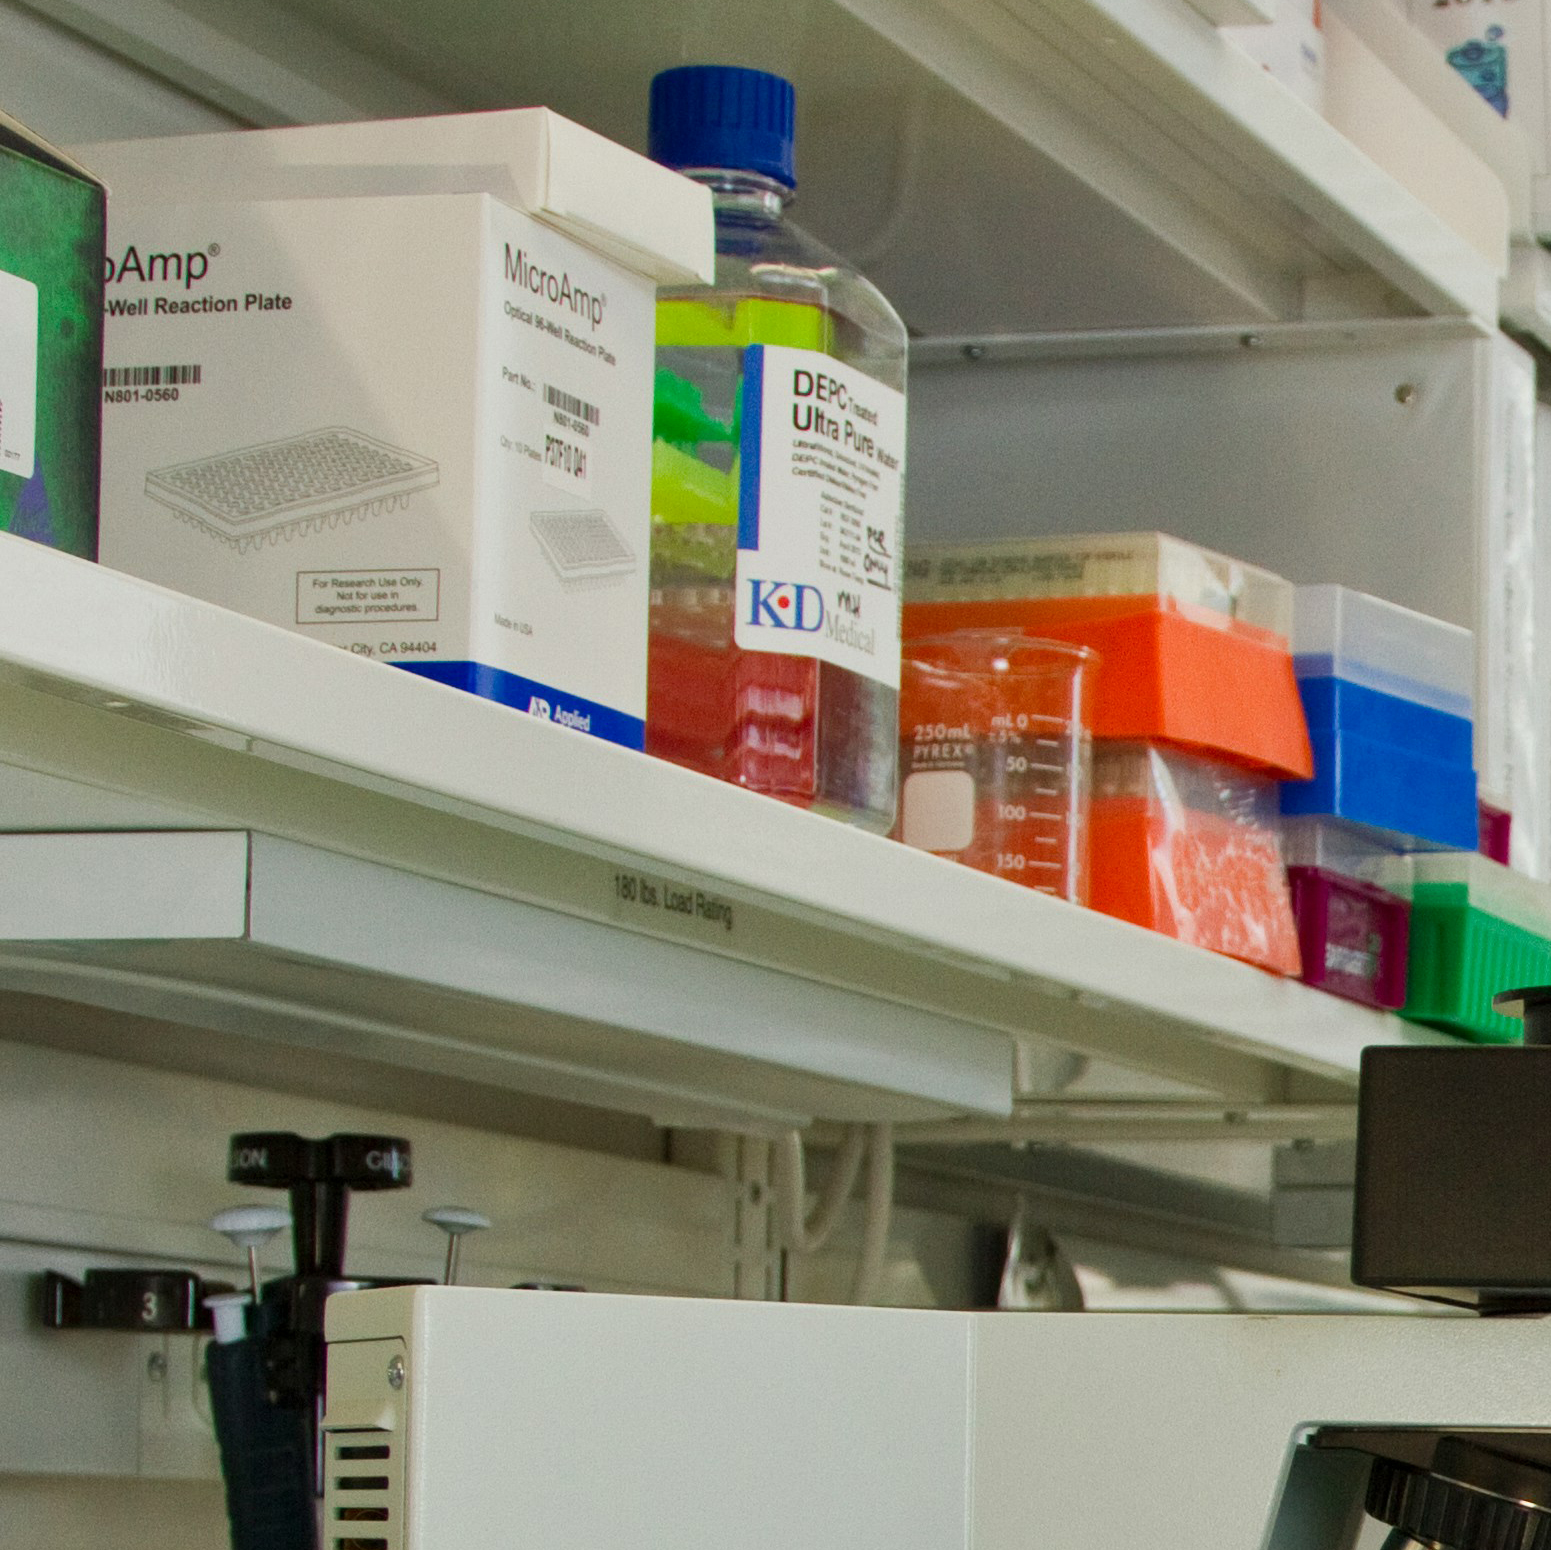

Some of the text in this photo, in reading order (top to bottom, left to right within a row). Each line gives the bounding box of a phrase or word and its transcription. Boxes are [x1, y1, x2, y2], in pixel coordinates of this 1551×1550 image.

[154, 296, 238, 315] Reaction
[244, 293, 293, 311] Plate
[504, 300, 533, 325] Optical
[104, 387, 180, 404] N801-0560
[794, 369, 847, 410] DEPC
[793, 403, 839, 441] Ultra
[844, 419, 875, 458] Pure
[312, 579, 328, 588] For
[331, 577, 376, 588] Research
[378, 577, 397, 588] Use
[336, 590, 399, 600] Not for use in
[315, 604, 362, 616] diagnostic
[746, 578, 824, 633] KD
[824, 609, 876, 656] Medical
[379, 641, 398, 654] CA
[400, 641, 437, 654] 94404
[1005, 756, 1028, 773] 50
[999, 804, 1027, 821] 100
[997, 853, 1026, 871] 150
[142, 1291, 158, 1320] 3
